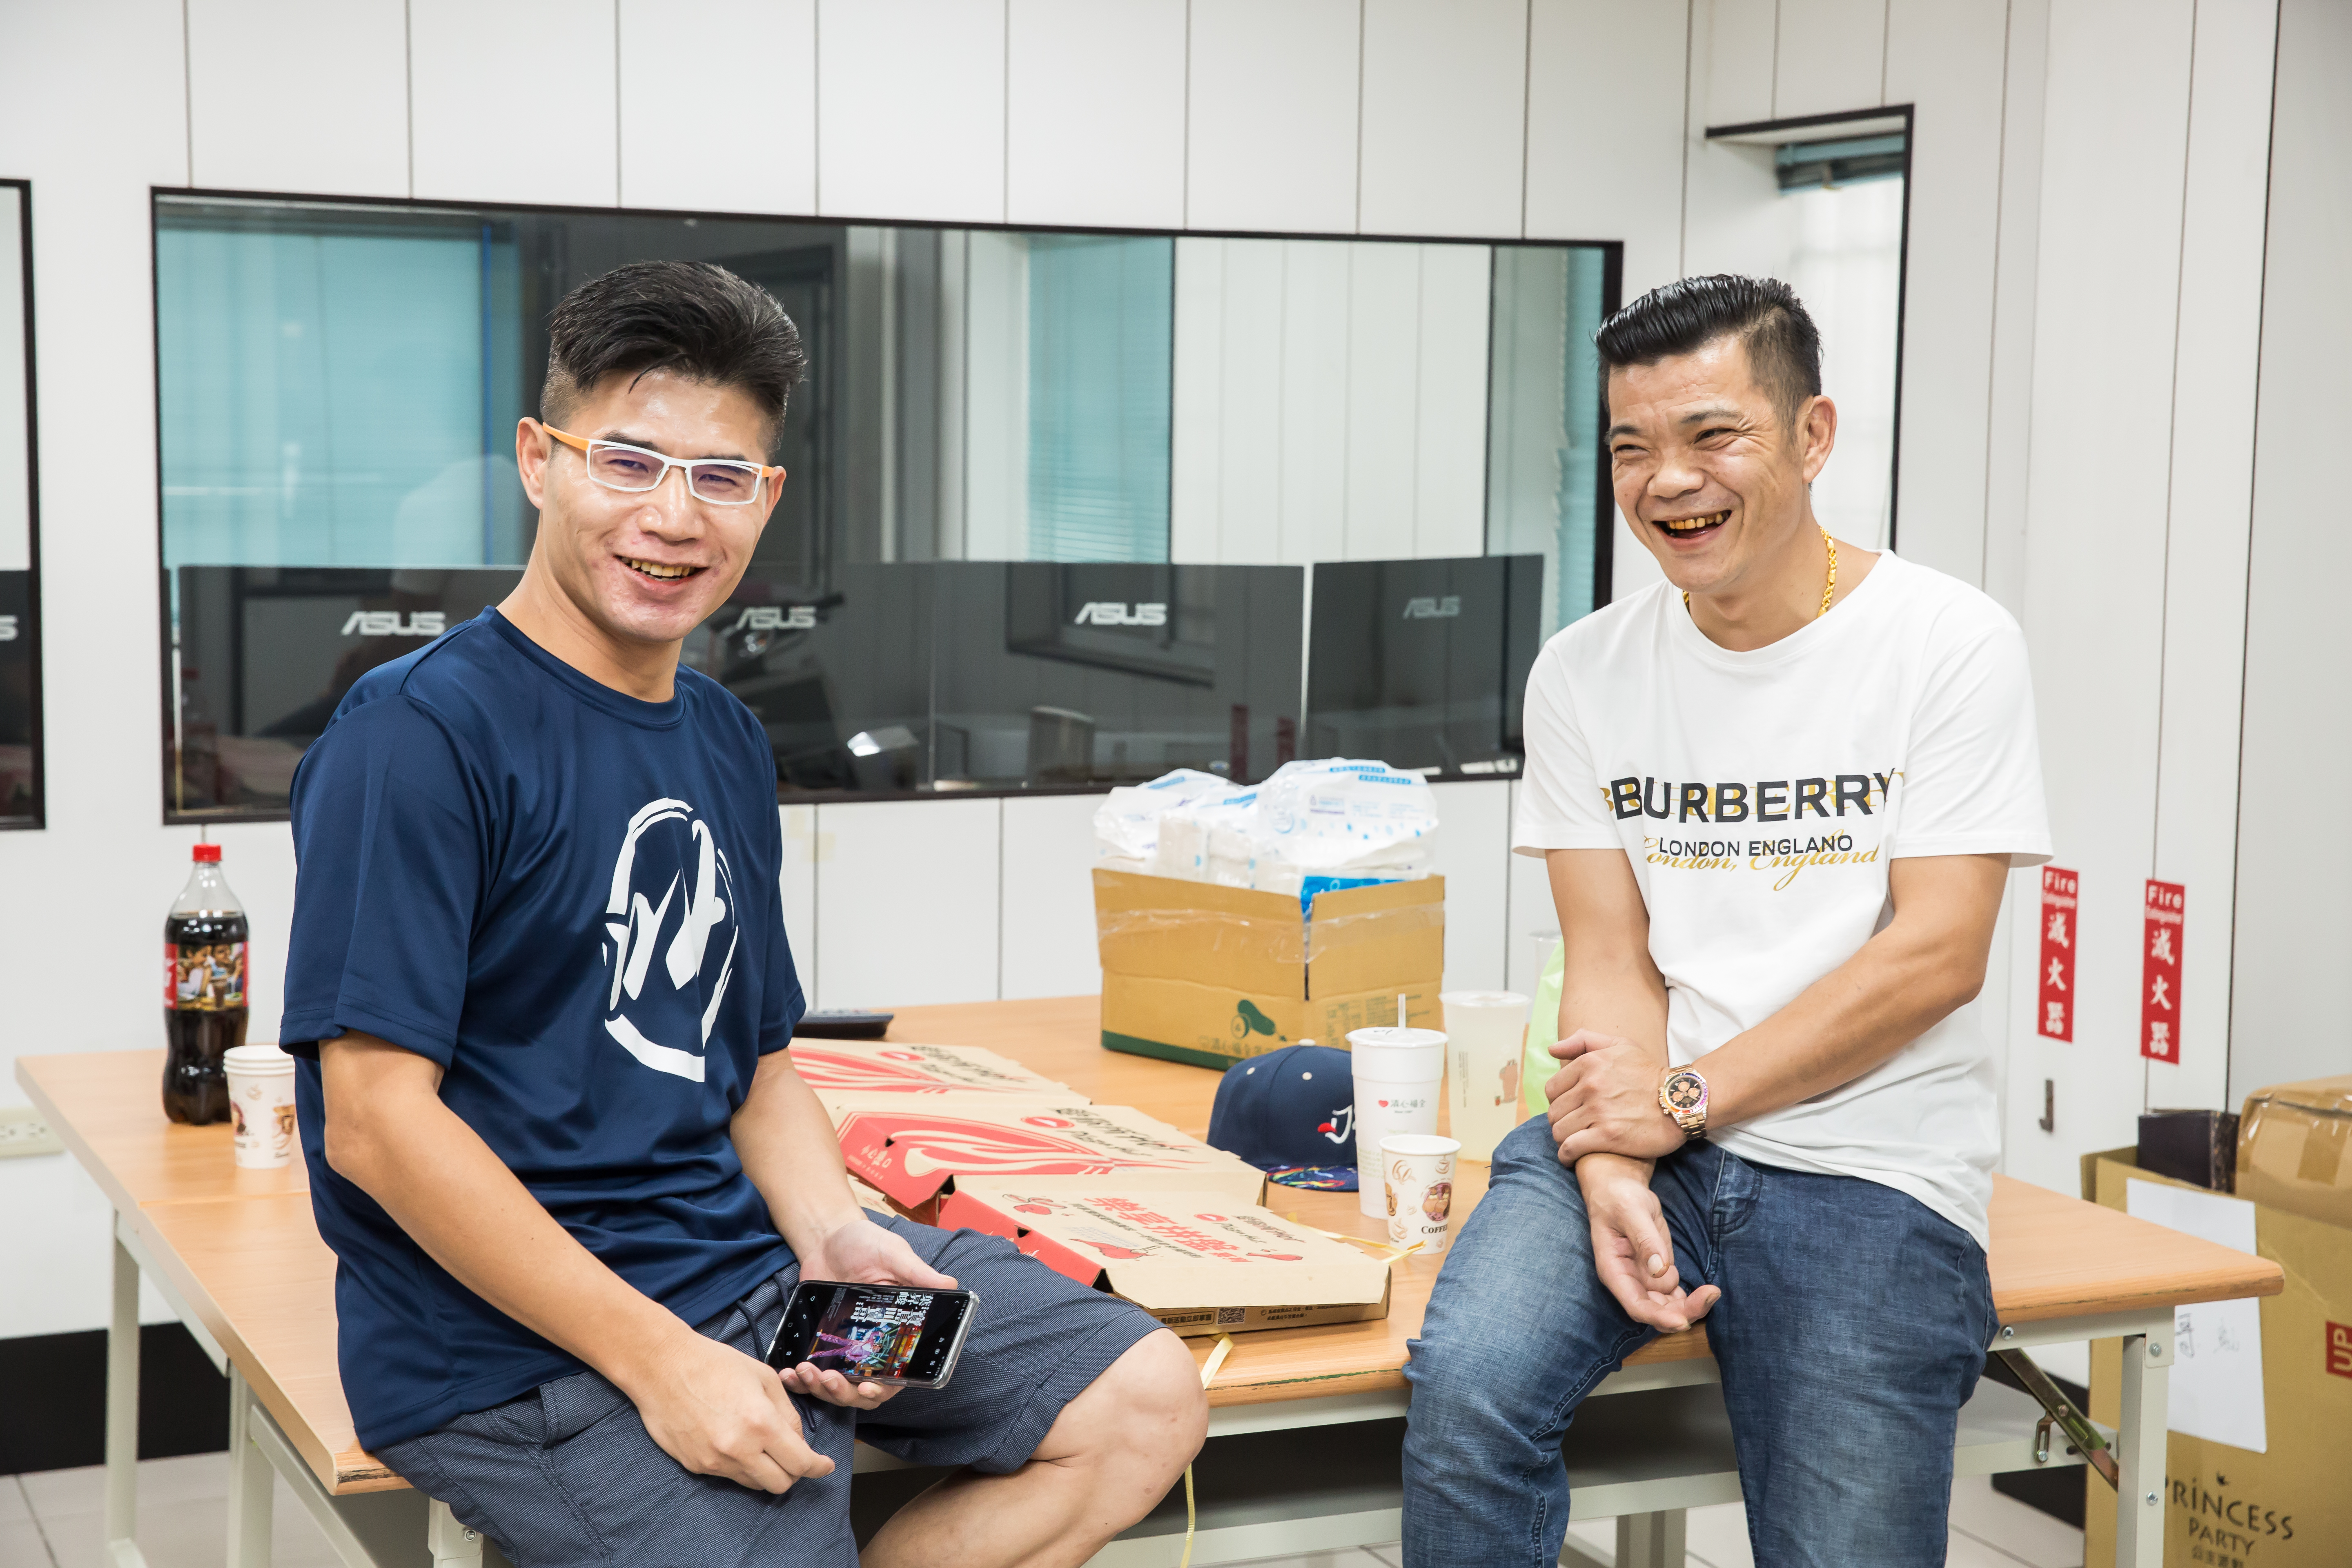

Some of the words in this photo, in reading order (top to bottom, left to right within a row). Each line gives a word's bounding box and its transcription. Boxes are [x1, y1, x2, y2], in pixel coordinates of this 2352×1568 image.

[735, 606, 816, 630] ASUS
[1074, 602, 1167, 626] ASUS
[1403, 595, 1461, 619] ASUS
[340, 611, 445, 636] ASUS
[1611, 768, 1895, 823] BURBERRY
[1659, 837, 1740, 857] LONDON
[1749, 829, 1880, 891] England
[2333, 1327, 2352, 1372] UP
[2189, 1516, 2256, 1556] PARTY
